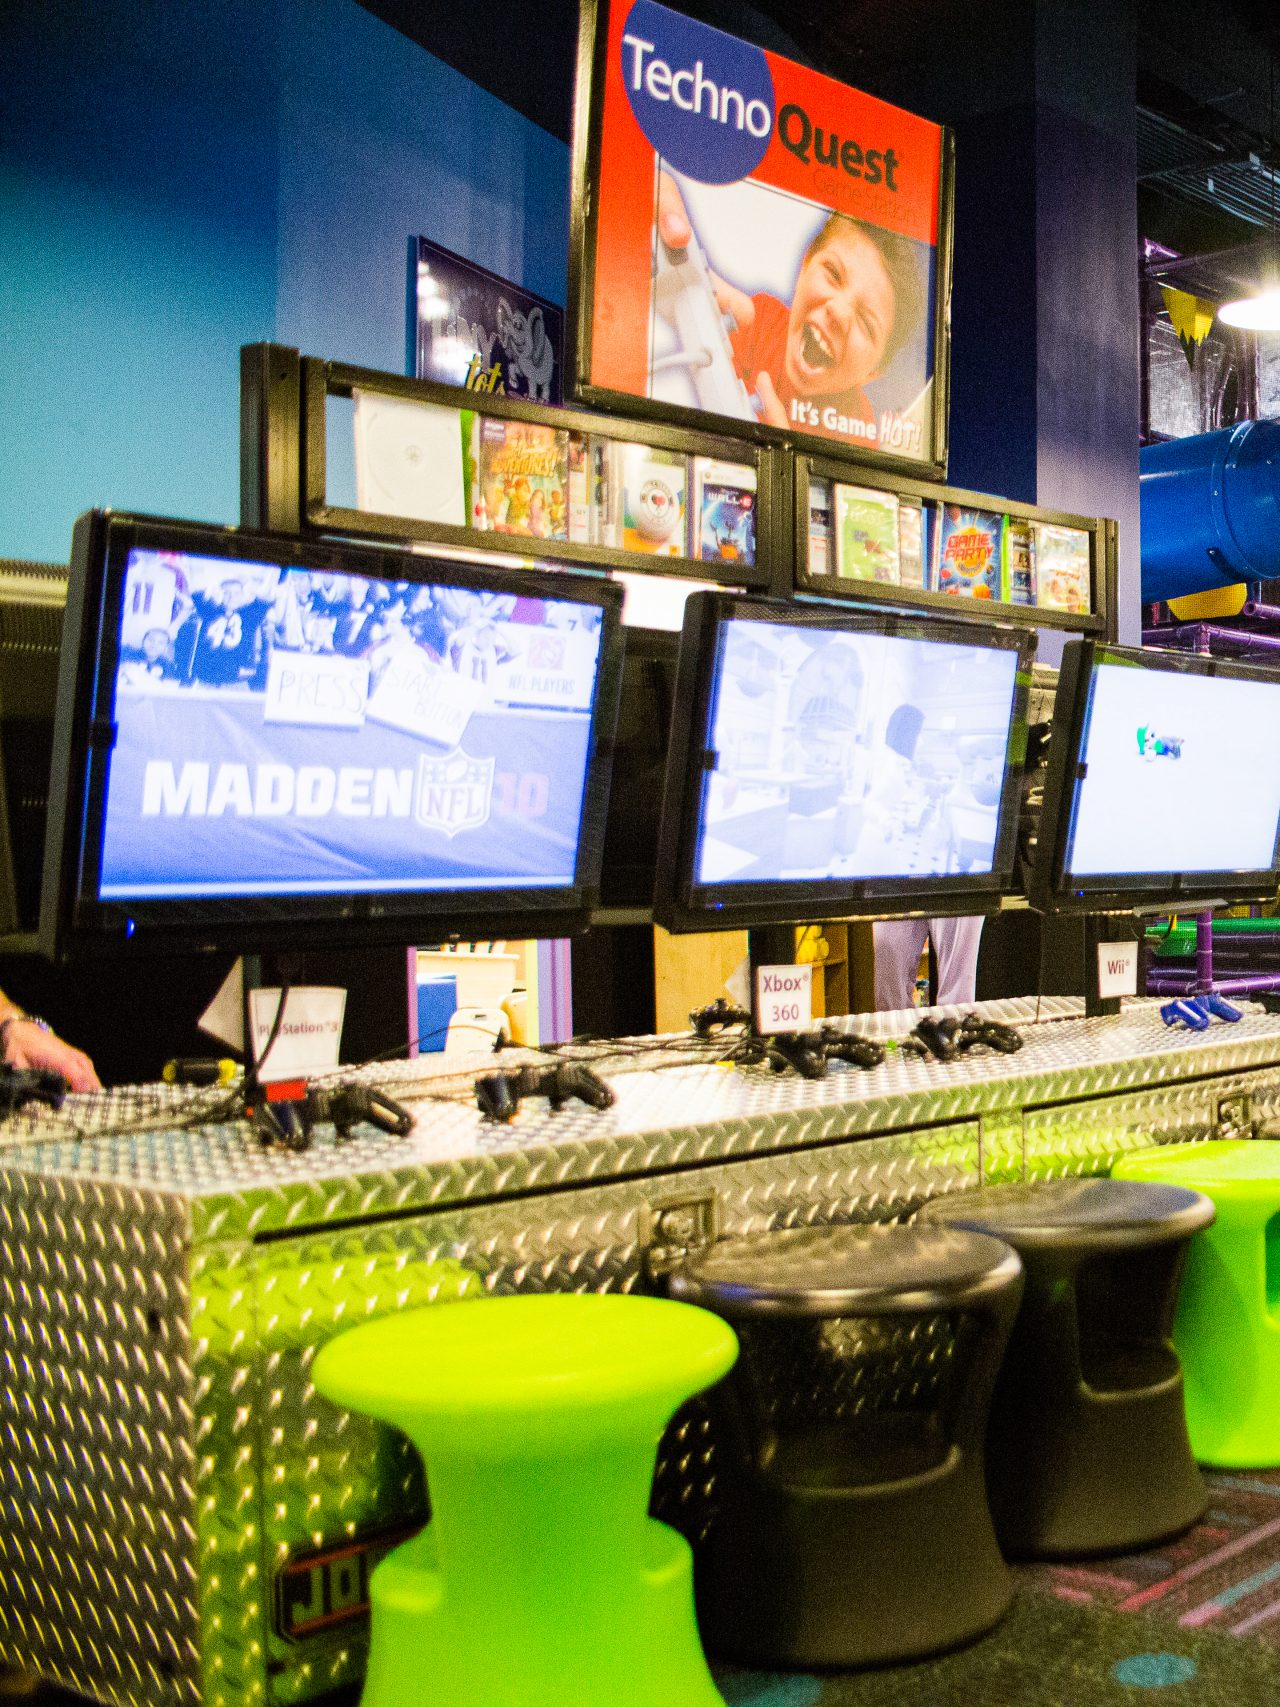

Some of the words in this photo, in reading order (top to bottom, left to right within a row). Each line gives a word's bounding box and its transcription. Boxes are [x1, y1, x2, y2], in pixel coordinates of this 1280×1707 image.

[622, 34, 772, 139] Techno
[777, 102, 901, 193] Quest
[790, 398, 820, 427] It's
[822, 407, 878, 441] Game
[879, 411, 922, 453] HOT!
[944, 545, 995, 563] PARTY
[946, 532, 992, 549] GAME
[206, 611, 243, 650] 43
[278, 669, 366, 715] PRESS
[385, 667, 448, 699] START
[530, 676, 576, 696] PLAYERS
[141, 759, 414, 818] MADDEN
[424, 786, 483, 824] NFL
[772, 1003, 799, 1022] 360
